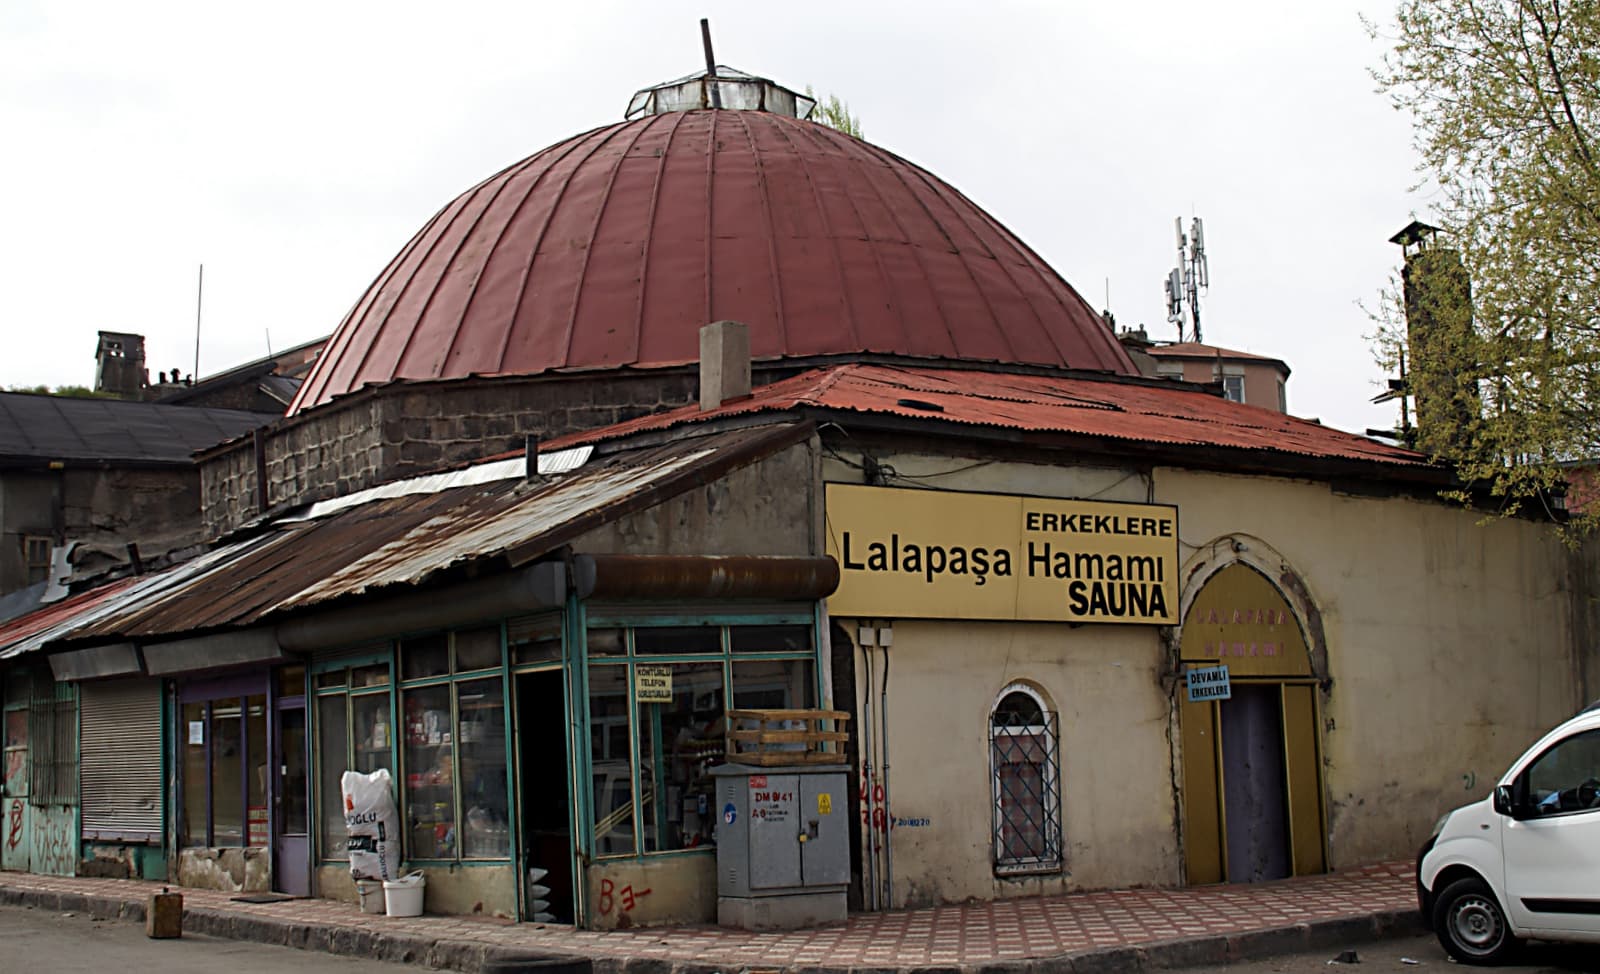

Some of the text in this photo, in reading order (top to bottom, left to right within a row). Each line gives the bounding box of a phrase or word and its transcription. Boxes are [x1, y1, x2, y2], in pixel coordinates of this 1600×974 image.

[1026, 512, 1172, 537] ERKEKLERE
[843, 532, 1164, 585] Lalapaşa Hamamı
[1068, 581, 1168, 618] SAUNA
[1191, 670, 1227, 685] DEVAMLI
[1191, 684, 1229, 699] ERKEKLERE
